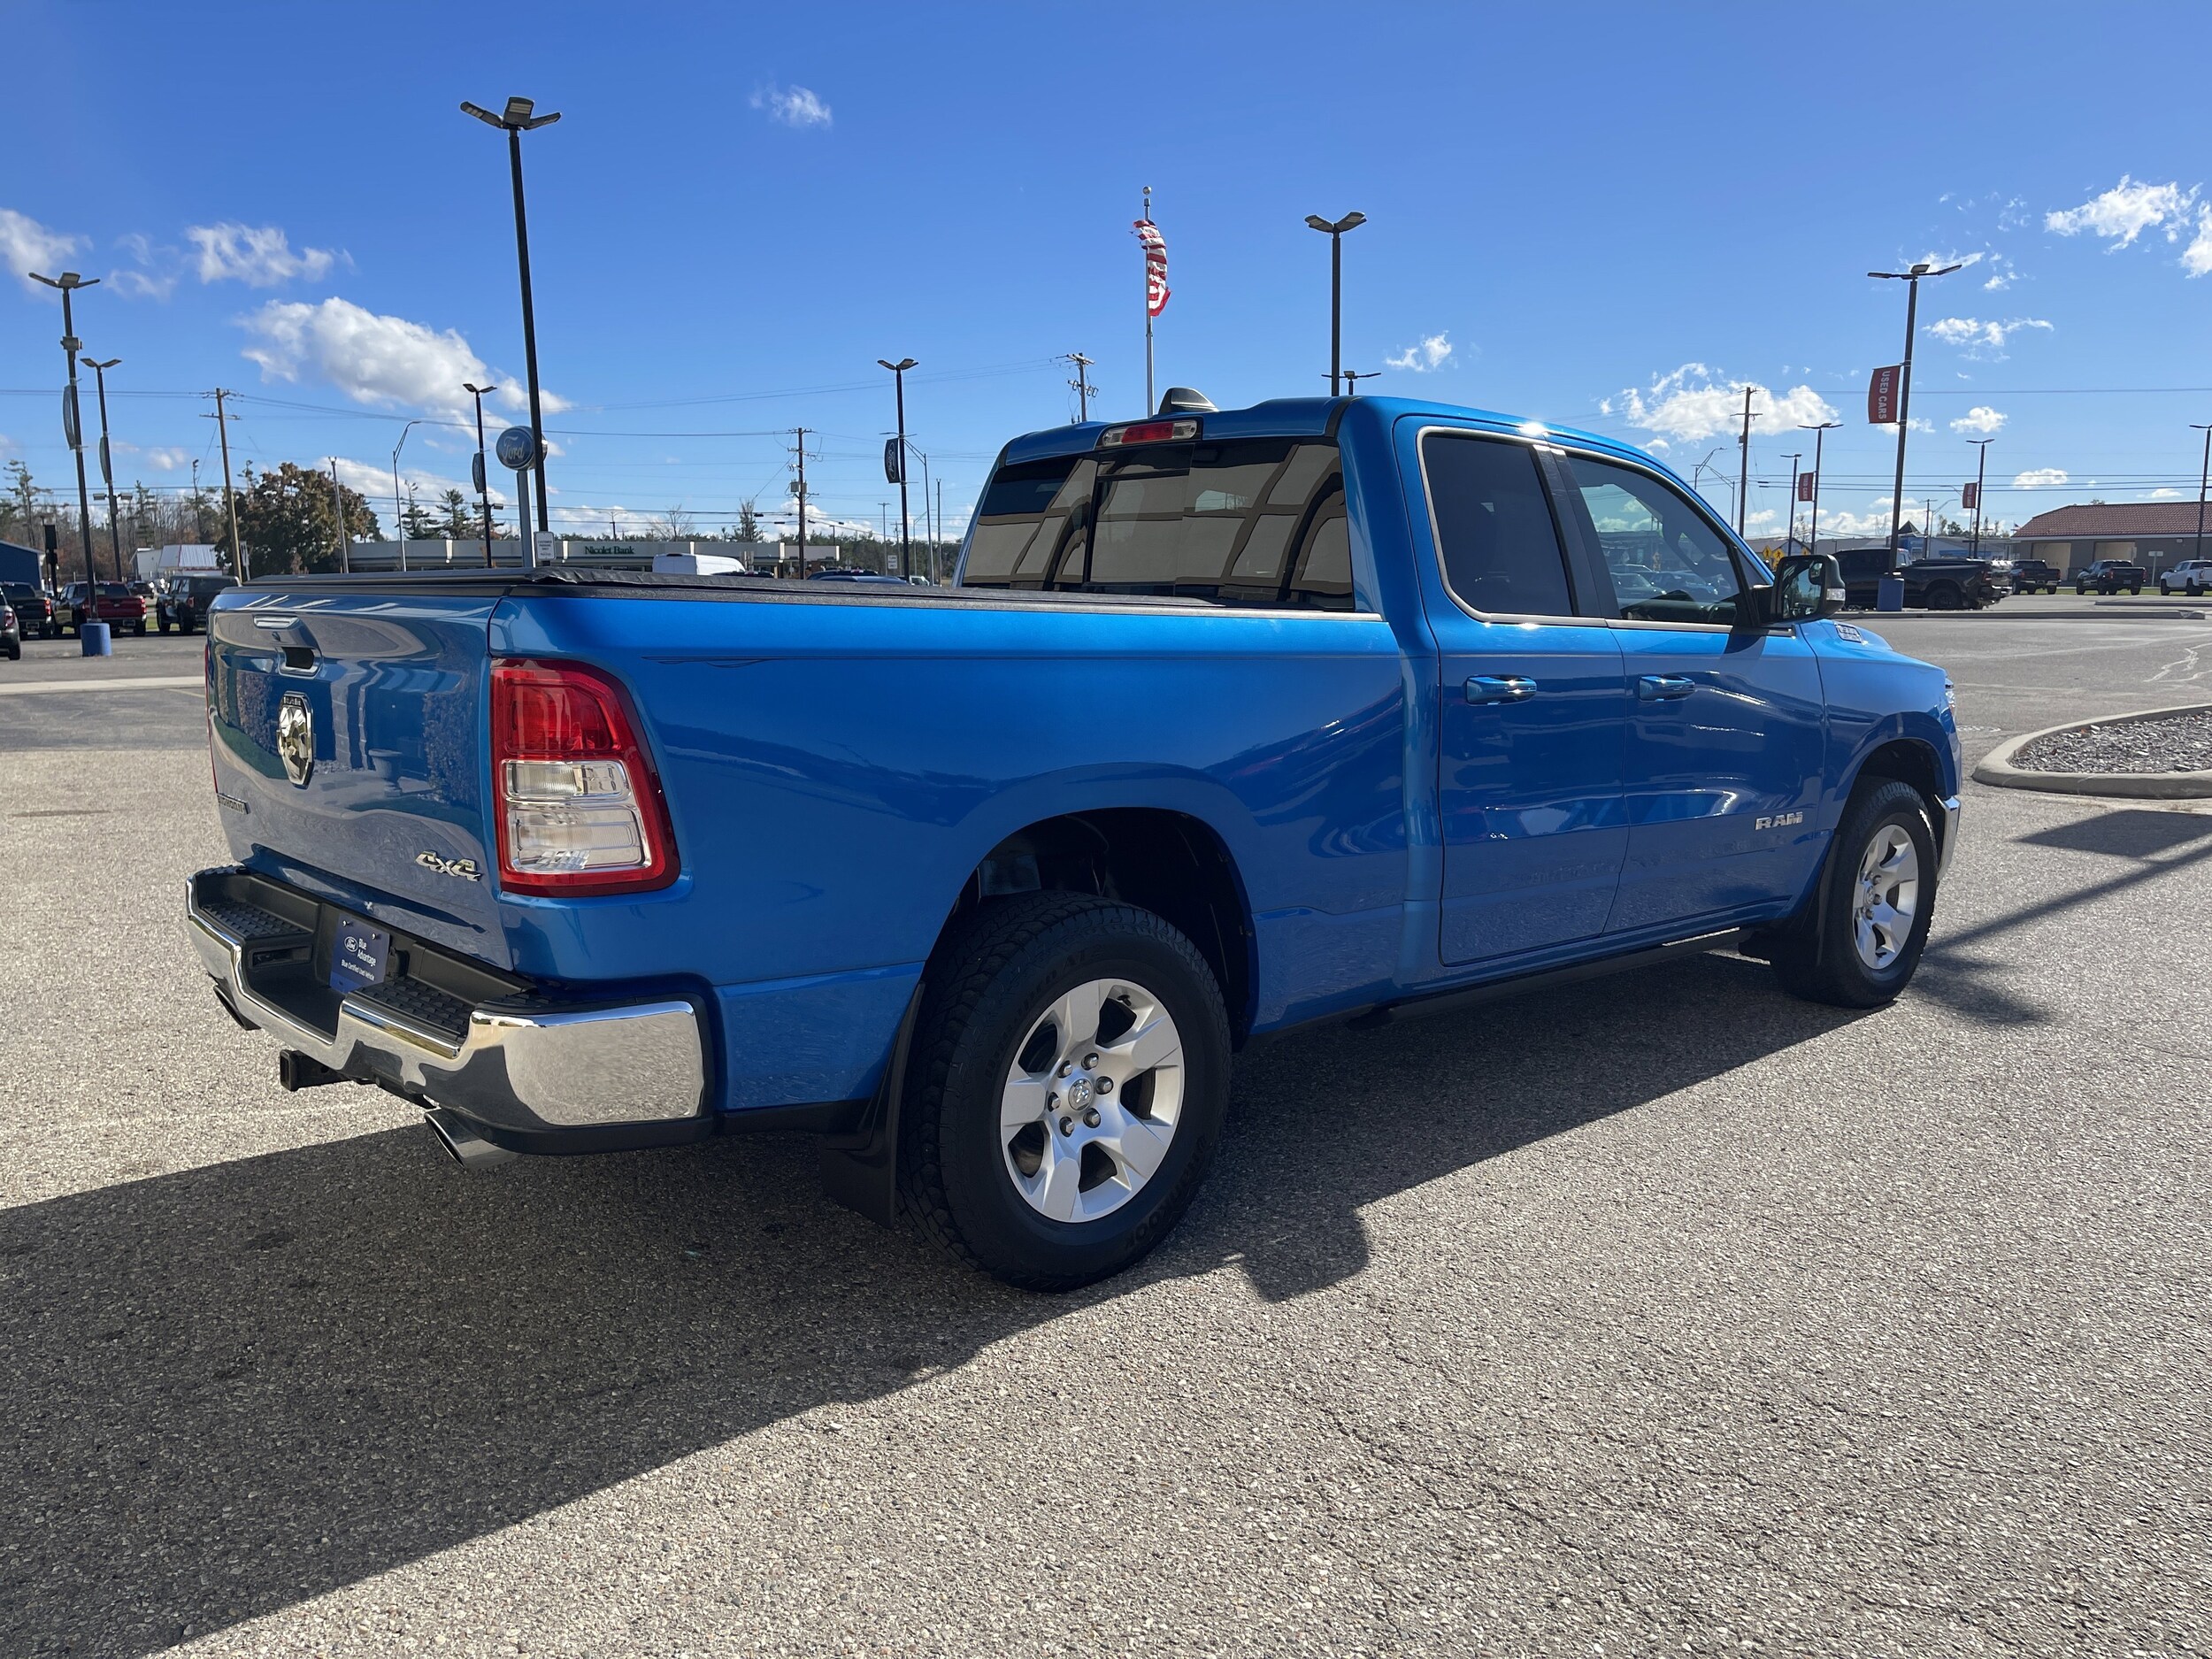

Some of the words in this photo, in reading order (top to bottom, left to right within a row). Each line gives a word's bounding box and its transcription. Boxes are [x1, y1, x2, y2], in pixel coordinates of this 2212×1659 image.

[1879, 371, 1891, 394] USED
[1878, 396, 1887, 419] CARS
[501, 435, 525, 460] Ford
[585, 546, 612, 555] Nicolet
[613, 546, 635, 555] Bank
[1755, 811, 1803, 830] RAM
[415, 850, 483, 882] 4x4
[358, 938, 367, 950] Blue
[357, 949, 377, 967] Advantage
